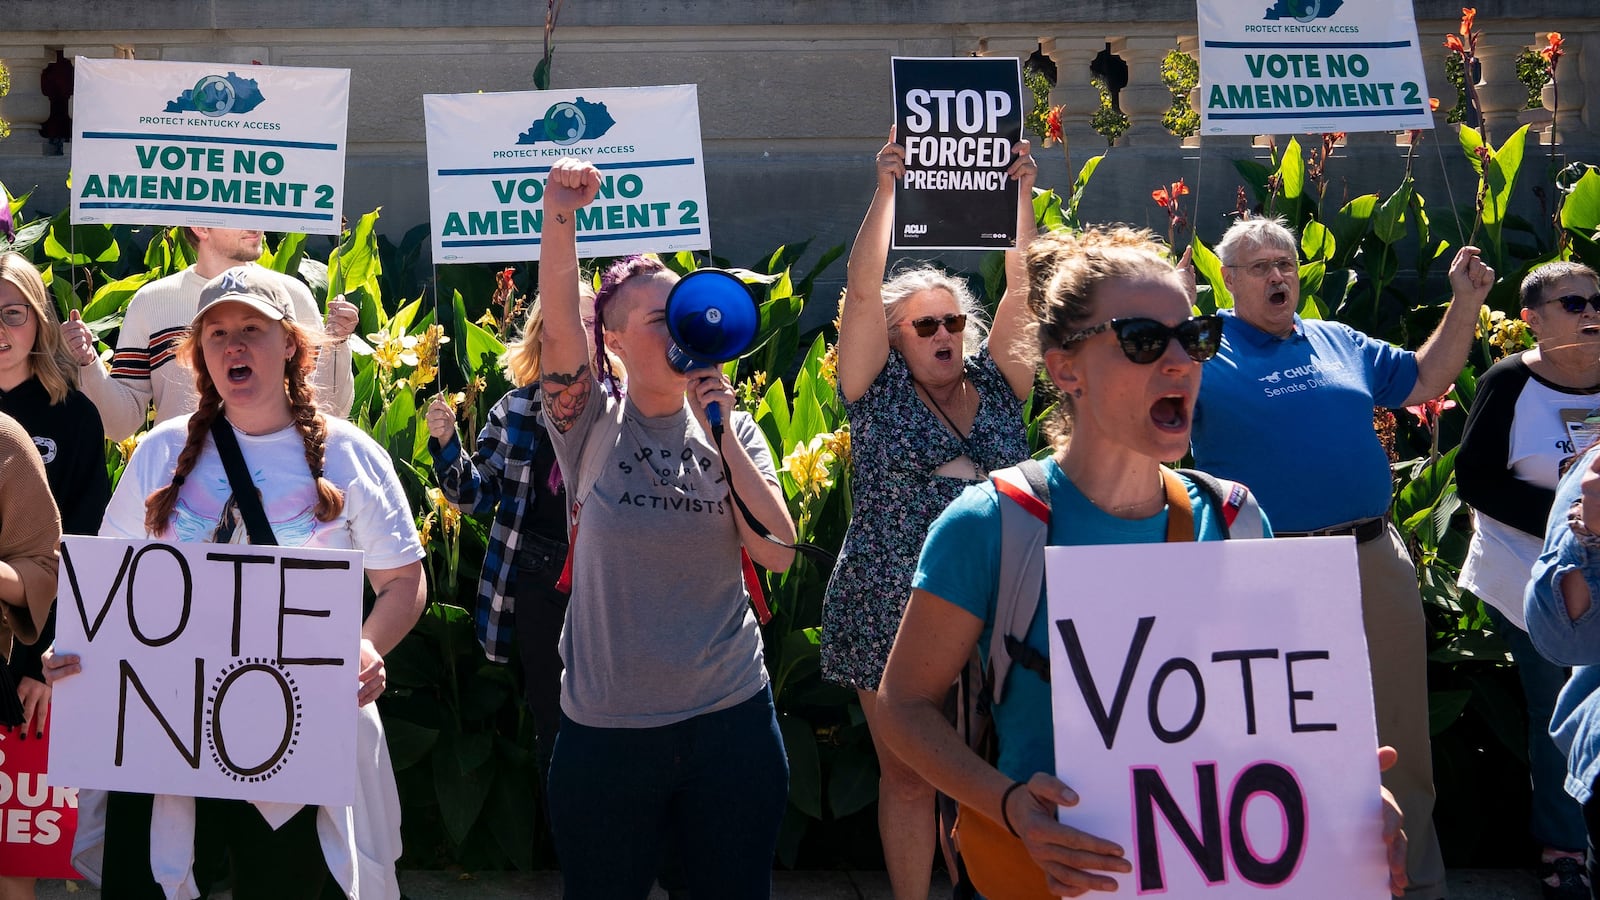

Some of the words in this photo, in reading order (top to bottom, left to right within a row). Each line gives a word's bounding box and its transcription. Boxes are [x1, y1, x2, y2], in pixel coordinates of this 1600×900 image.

[1245, 24, 1282, 33] PROTECT
[1284, 24, 1327, 33] KENTUCKY
[1329, 25, 1359, 33] ACCESS
[1245, 54, 1321, 78] VOTE
[1326, 53, 1369, 78] NO
[1208, 83, 1394, 108] AMENDMENT
[1398, 82, 1422, 104] 2
[139, 116, 185, 126] PROTECT
[187, 118, 240, 128] KENTUCKY
[242, 121, 281, 131] ACCESS
[905, 88, 1012, 134] STOP
[136, 145, 224, 173] VOTE
[233, 149, 284, 176] NO
[493, 149, 539, 159] PROTECT
[541, 147, 594, 157] KENTUCKY
[596, 145, 635, 154] ACCESS
[905, 136, 1010, 167] FORCED
[81, 174, 308, 208] AMENDMENT
[315, 184, 334, 209] 2
[492, 177, 549, 204] VO
[904, 170, 1008, 191] PREGNANCY
[442, 203, 671, 236] AMENMENT
[678, 200, 699, 225] 2
[904, 224, 928, 234] ACLU
[1264, 383, 1307, 397] Senate
[653, 479, 697, 492] LOAL
[619, 491, 725, 514] ACTIVISTS
[60, 541, 350, 666] VOTE
[1055, 616, 1337, 750] VOTE
[114, 658, 296, 778] NO
[0, 808, 63, 845] ES
[1128, 759, 1309, 896] NO
